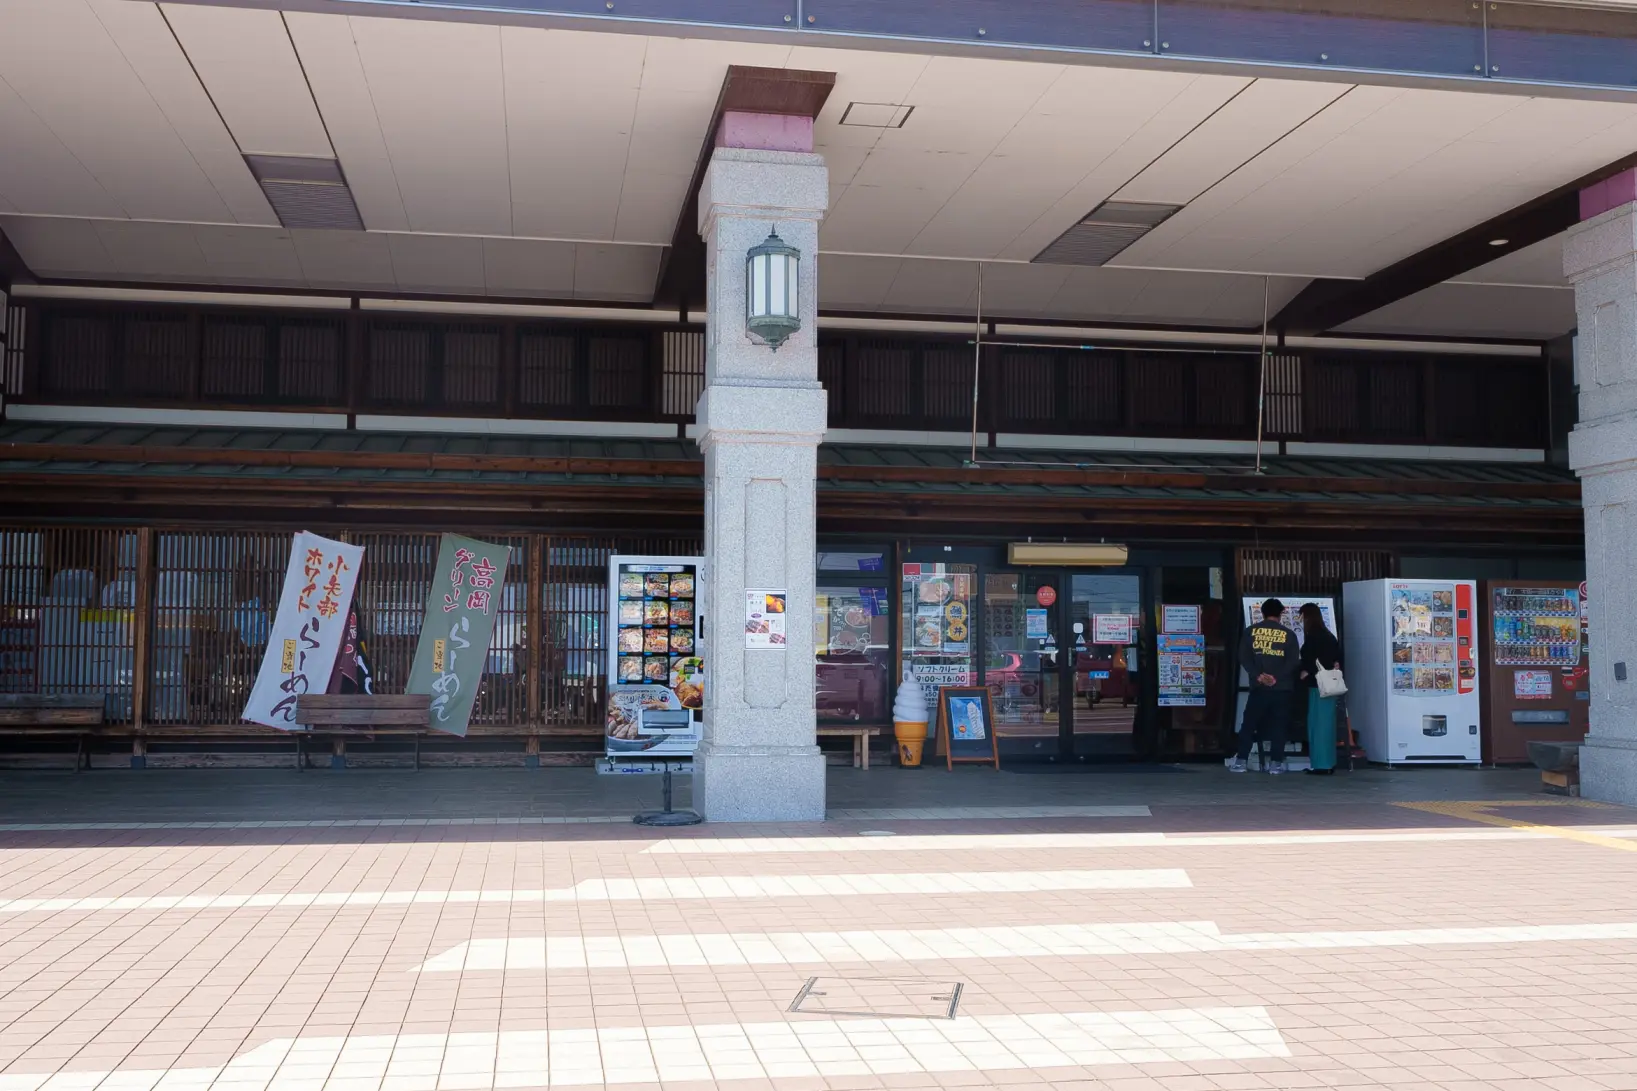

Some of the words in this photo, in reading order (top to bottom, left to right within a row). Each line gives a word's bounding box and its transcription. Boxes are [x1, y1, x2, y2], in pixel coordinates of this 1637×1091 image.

[298, 548, 324, 614] ホワイト
[317, 554, 350, 620] 小矢部
[443, 548, 475, 613] グリーン
[467, 556, 497, 615] 高岡
[1251, 627, 1288, 639] LOWER
[1252, 640, 1273, 649] CALI
[270, 616, 321, 722] らーめん
[430, 616, 471, 722] らーめん
[917, 665, 966, 673] ソフトクリーム
